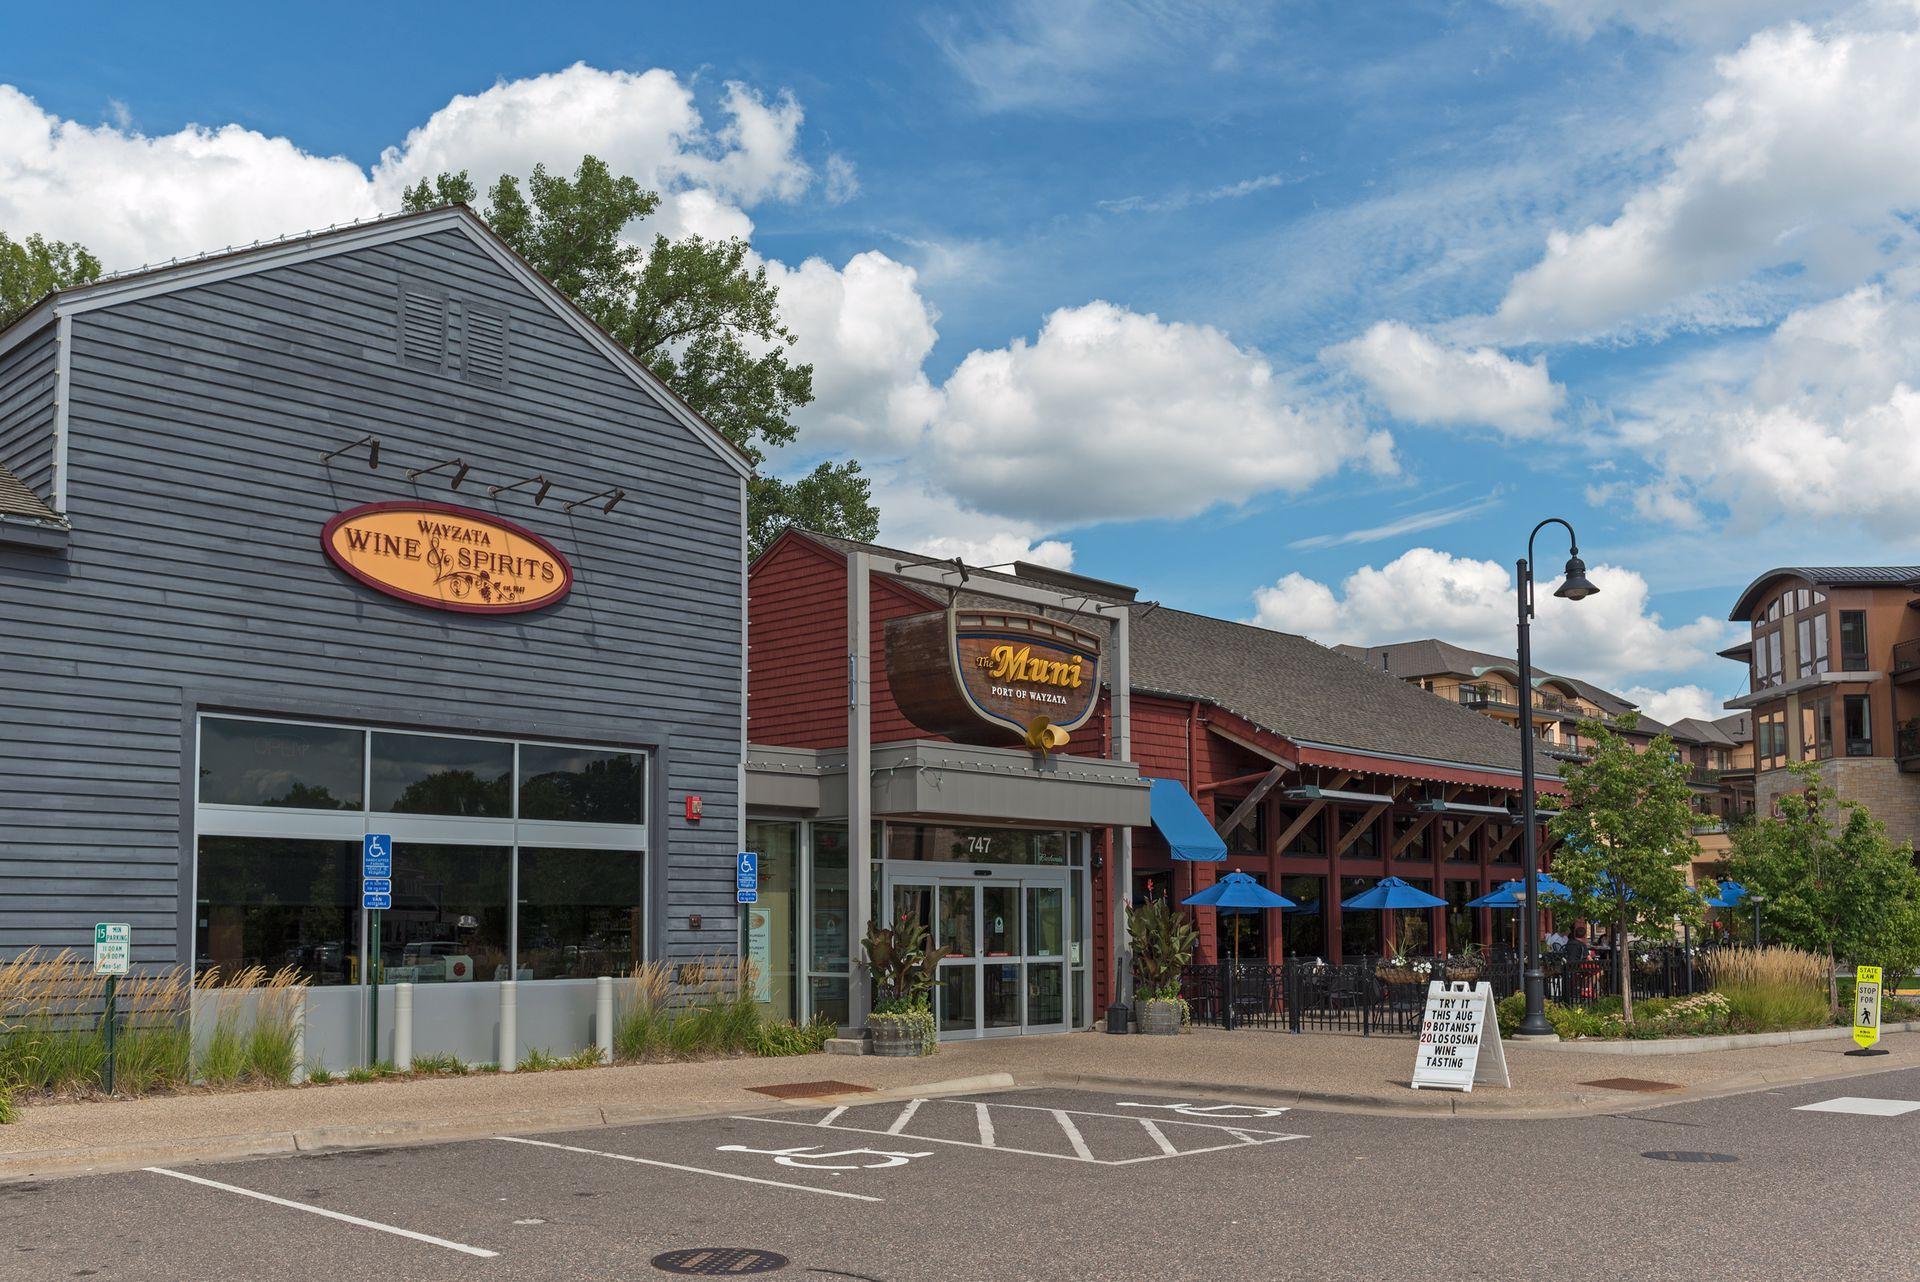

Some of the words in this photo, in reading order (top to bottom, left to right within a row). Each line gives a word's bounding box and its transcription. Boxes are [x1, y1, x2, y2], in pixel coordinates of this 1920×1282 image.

[418, 520, 491, 545] WAYZATA
[344, 527, 422, 560] WINE
[458, 547, 554, 582] SPIRITS
[976, 656, 994, 668] The
[989, 645, 1082, 688] Muni
[992, 686, 1013, 697] PORT
[1016, 690, 1027, 700] OF
[1030, 691, 1067, 705] WAYZATA
[968, 836, 991, 854] 747
[98, 928, 105, 938] 15
[1440, 999, 1456, 1008] TRY
[1461, 1000, 1470, 1009] IT
[1432, 1010, 1451, 1020] THIS
[1455, 1011, 1473, 1021] AUG
[1423, 1021, 1432, 1031] 19
[1433, 1022, 1476, 1033] BOTANIST
[1420, 1034, 1432, 1043] 20
[1434, 1046, 1456, 1056] WINE
[1426, 1057, 1463, 1068] TASTING
